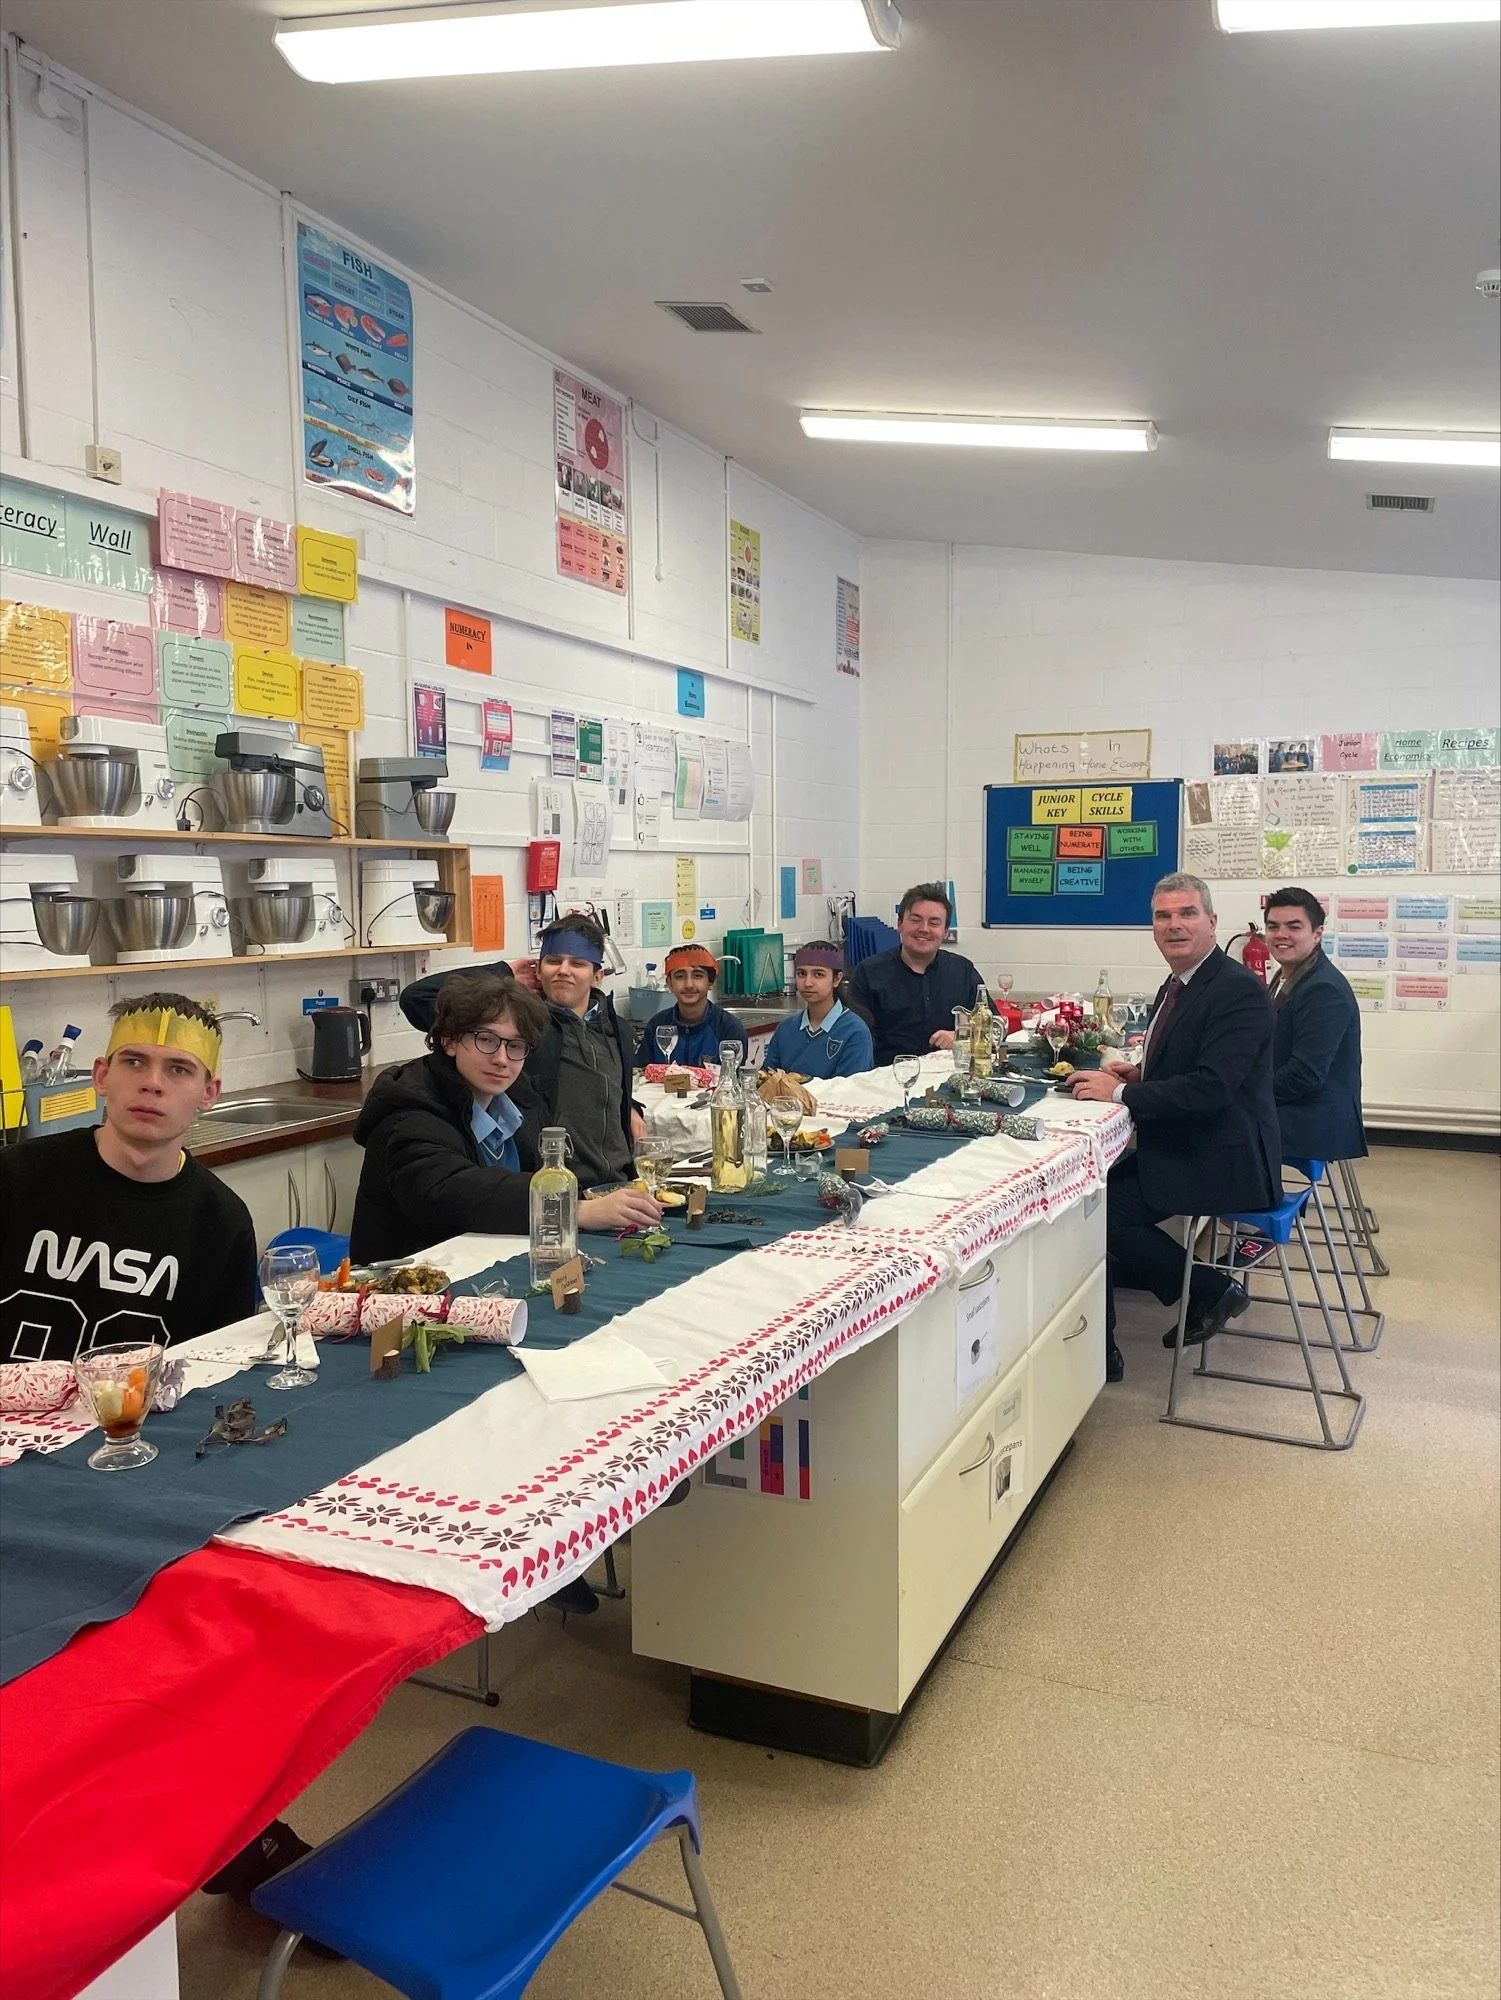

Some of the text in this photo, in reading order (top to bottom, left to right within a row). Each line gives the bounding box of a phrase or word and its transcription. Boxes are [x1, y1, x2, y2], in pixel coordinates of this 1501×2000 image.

[343, 250, 373, 279] FISH
[360, 347, 372, 358] FISH
[581, 387, 602, 408] MEAT
[359, 400, 372, 409] FISH
[362, 451, 374, 461] FISH
[90, 521, 131, 550] Wall
[449, 622, 487, 641] NUMERACY
[1019, 739, 1121, 755] Whats In
[1338, 739, 1361, 747] Junior
[1395, 738, 1422, 746] Home
[1442, 738, 1489, 749] Recipes
[1384, 752, 1432, 761] Economics
[1019, 758, 1076, 776] Happening
[1038, 794, 1076, 805] JUNIOR
[1091, 793, 1124, 802] CYCLE
[1046, 808, 1067, 818] KEY
[1089, 806, 1124, 816] SKILLS
[1013, 833, 1050, 841] STAYING
[1020, 844, 1041, 852] WELL
[1060, 841, 1100, 849] NUMERATE
[1013, 867, 1050, 875] MANAGING
[1067, 866, 1093, 874] BEING
[1059, 878, 1099, 886] CREATIVE
[24, 1229, 179, 1301] NASA
